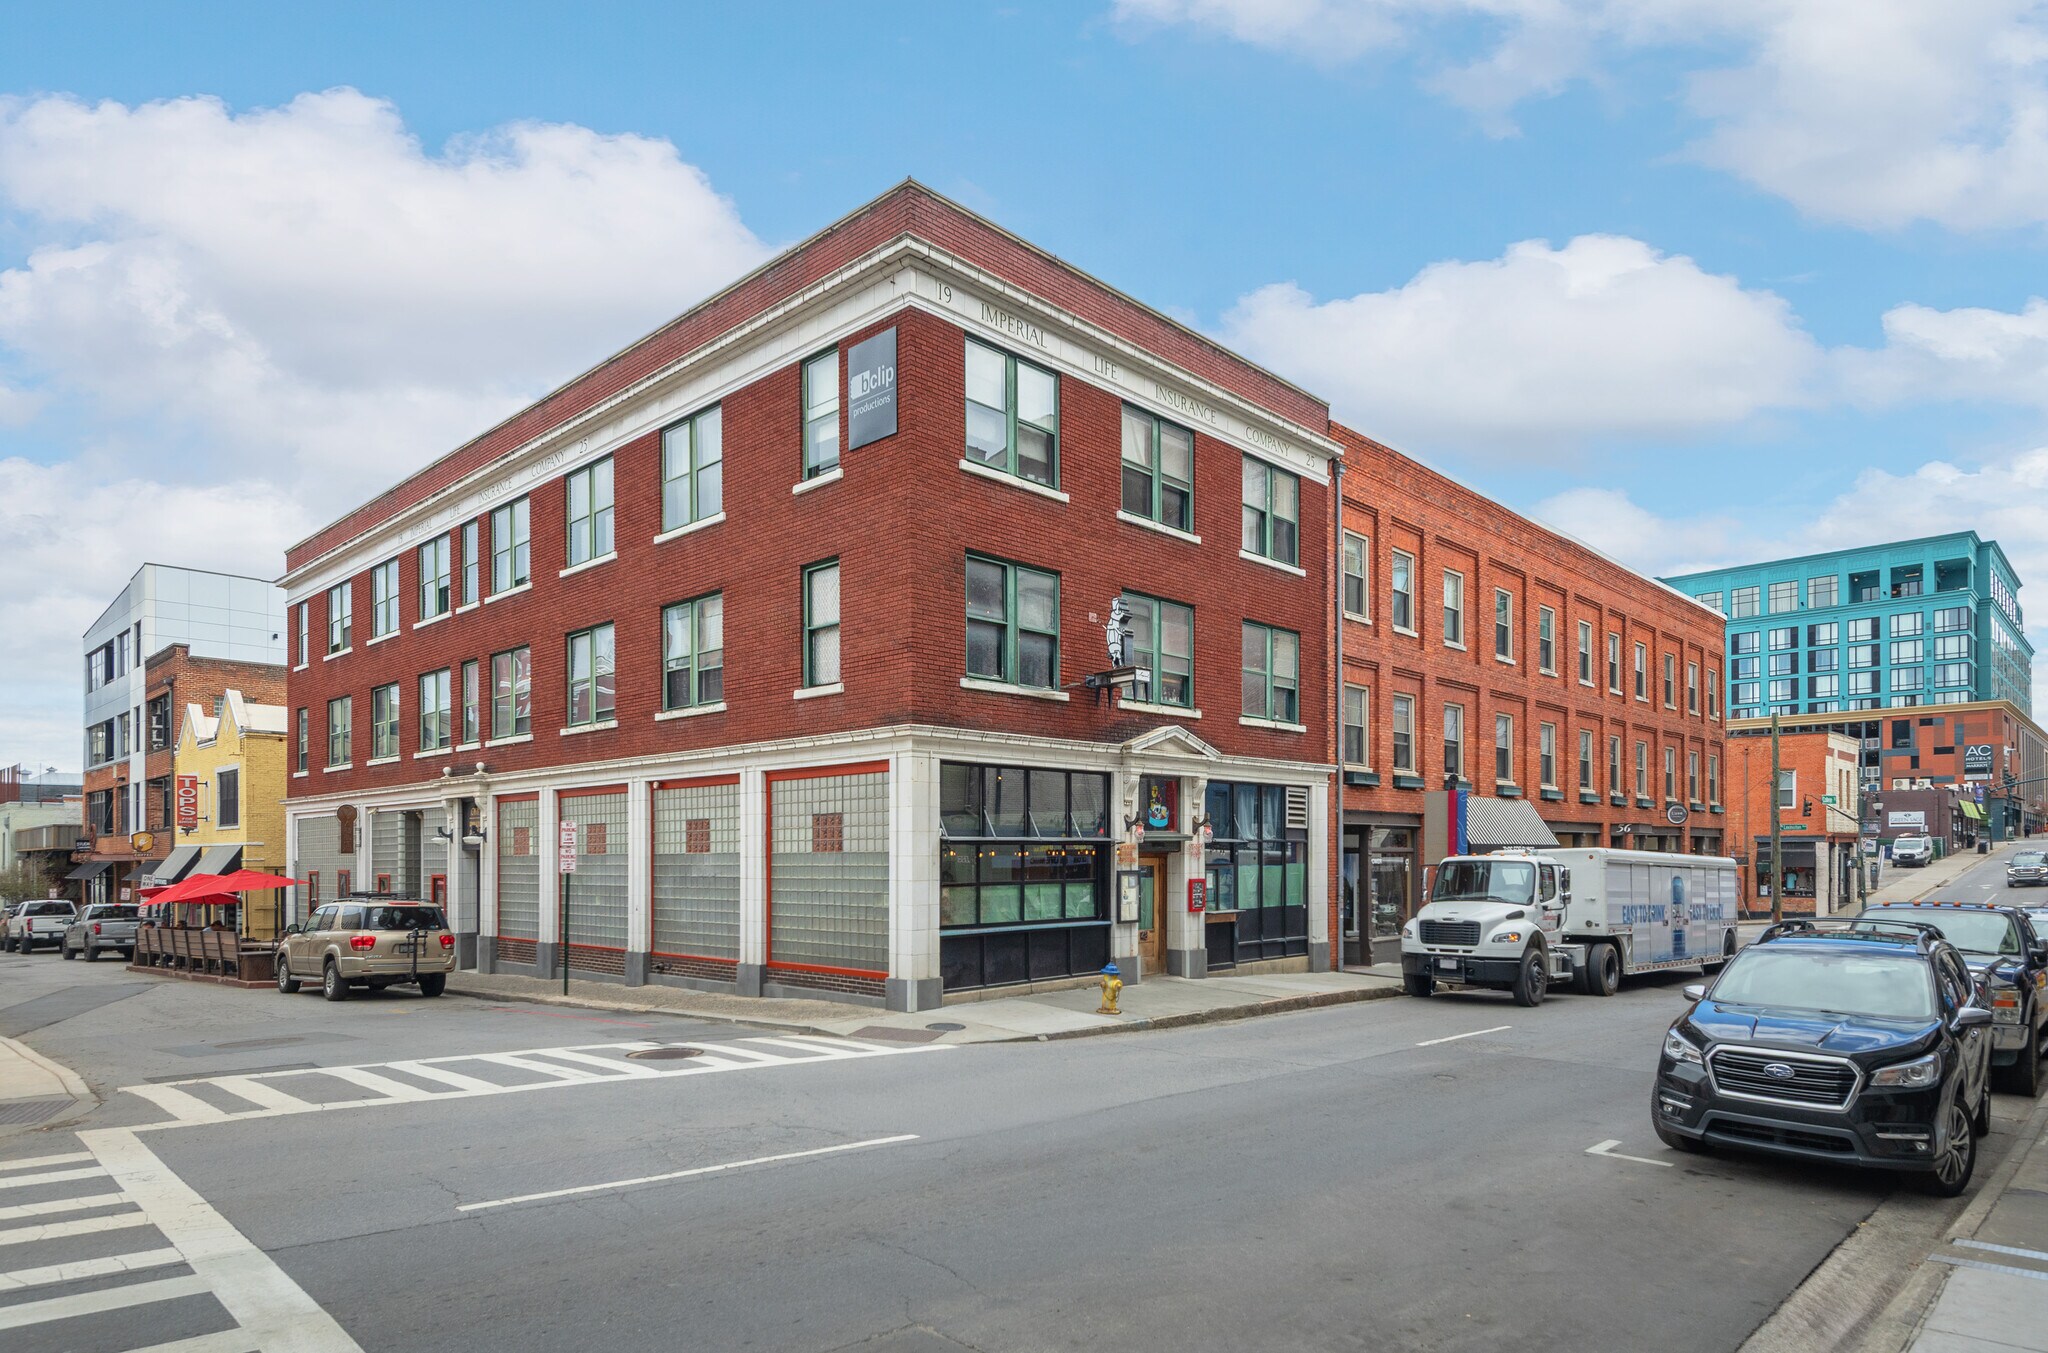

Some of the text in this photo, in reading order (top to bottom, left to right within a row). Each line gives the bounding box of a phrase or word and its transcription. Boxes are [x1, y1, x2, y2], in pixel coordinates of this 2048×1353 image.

[938, 283, 1315, 468] 19 IMPERIAL LIFE INSURANCE COMPANY 25
[853, 394, 891, 419] productions
[479, 478, 513, 502] INSURANCE
[531, 450, 566, 477] COMPANY
[579, 438, 588, 454] 25
[1965, 744, 1992, 757] AC
[178, 777, 197, 816] TOPS
[1616, 824, 1632, 833] 56
[1622, 905, 1638, 924] EASY
[1639, 905, 1647, 923] TO
